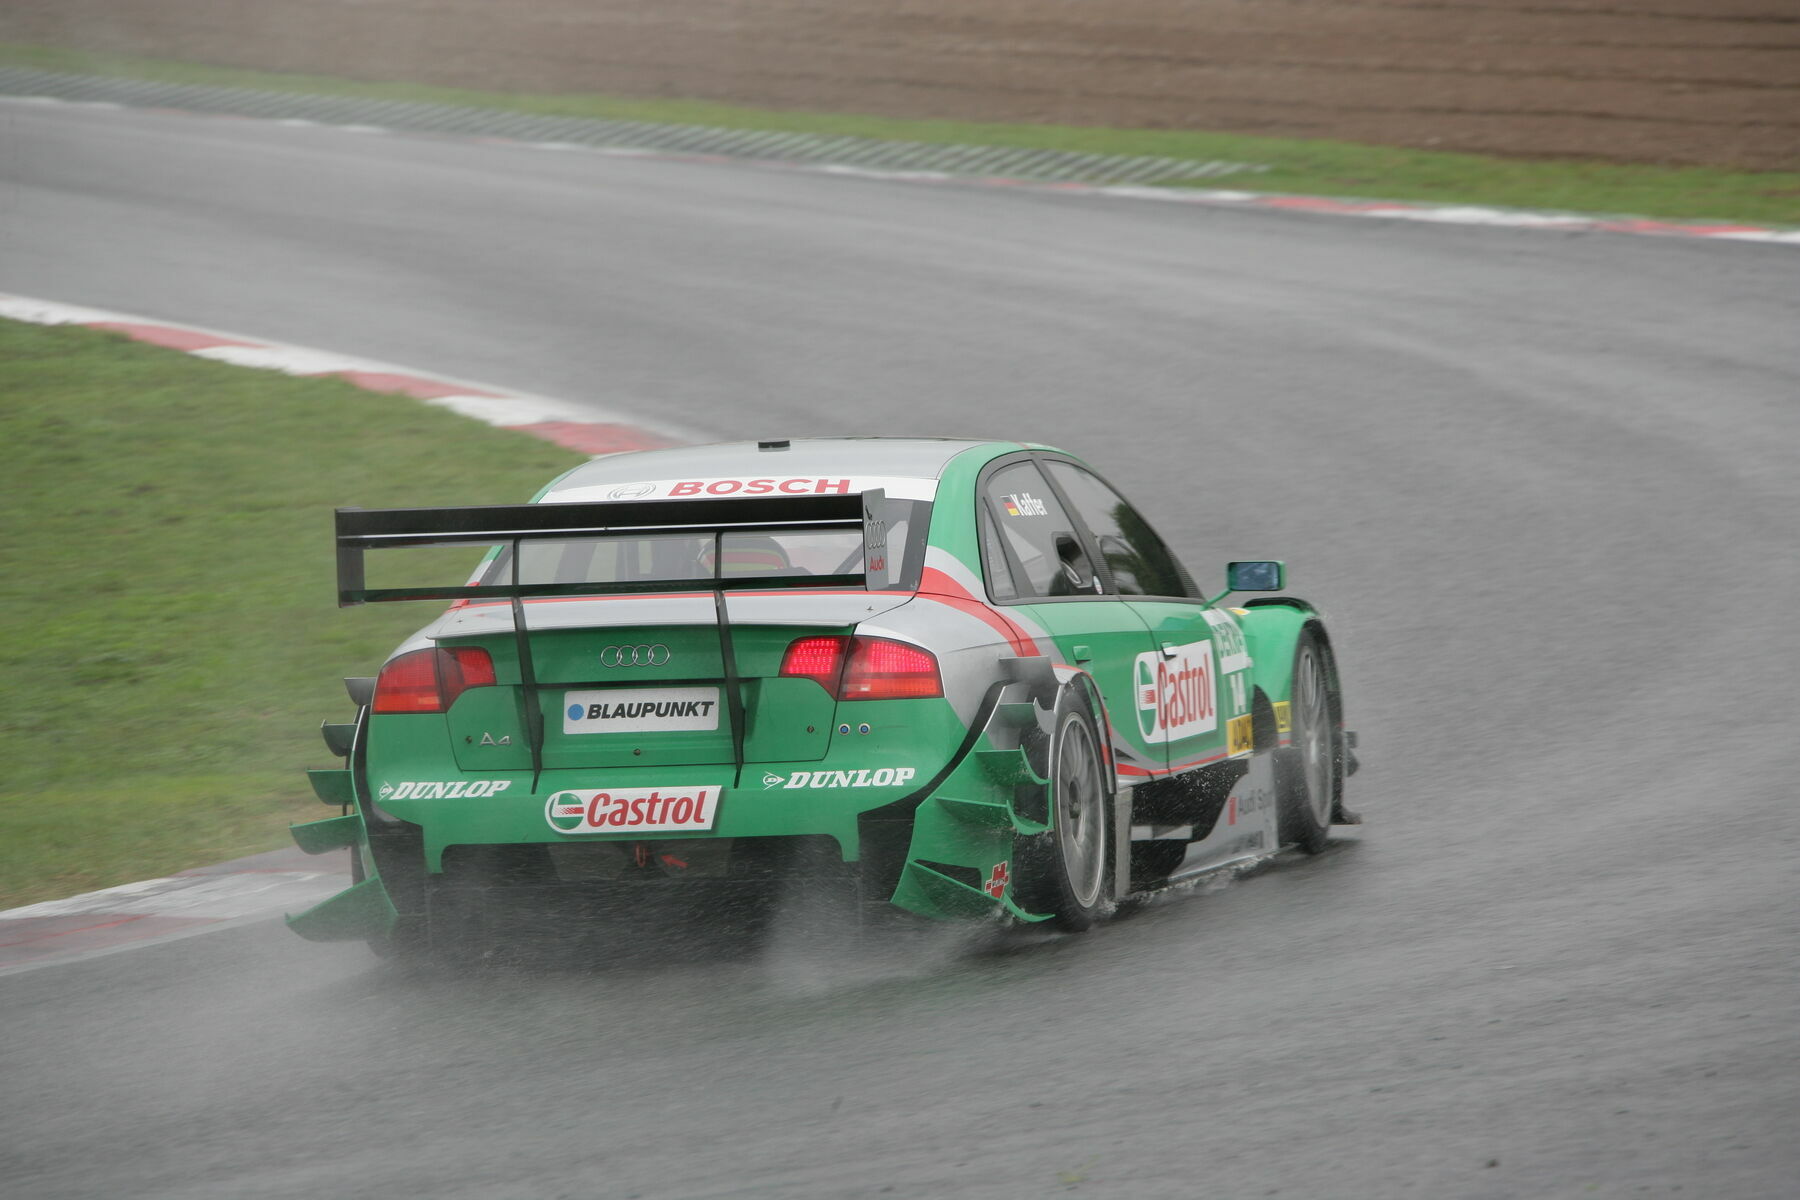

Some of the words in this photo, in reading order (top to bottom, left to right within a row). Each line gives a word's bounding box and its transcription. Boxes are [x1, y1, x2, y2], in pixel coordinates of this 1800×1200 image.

[668, 479, 851, 497] BOSCH
[1010, 492, 1048, 516] Kaffer
[869, 555, 885, 571] Audi
[1157, 653, 1213, 730] Castrol
[587, 701, 714, 720] BLAUPUNKT
[479, 732, 512, 746] A4
[783, 767, 915, 789] DUNLOP
[388, 781, 512, 801] DUNLOP
[587, 790, 708, 828] Castrol
